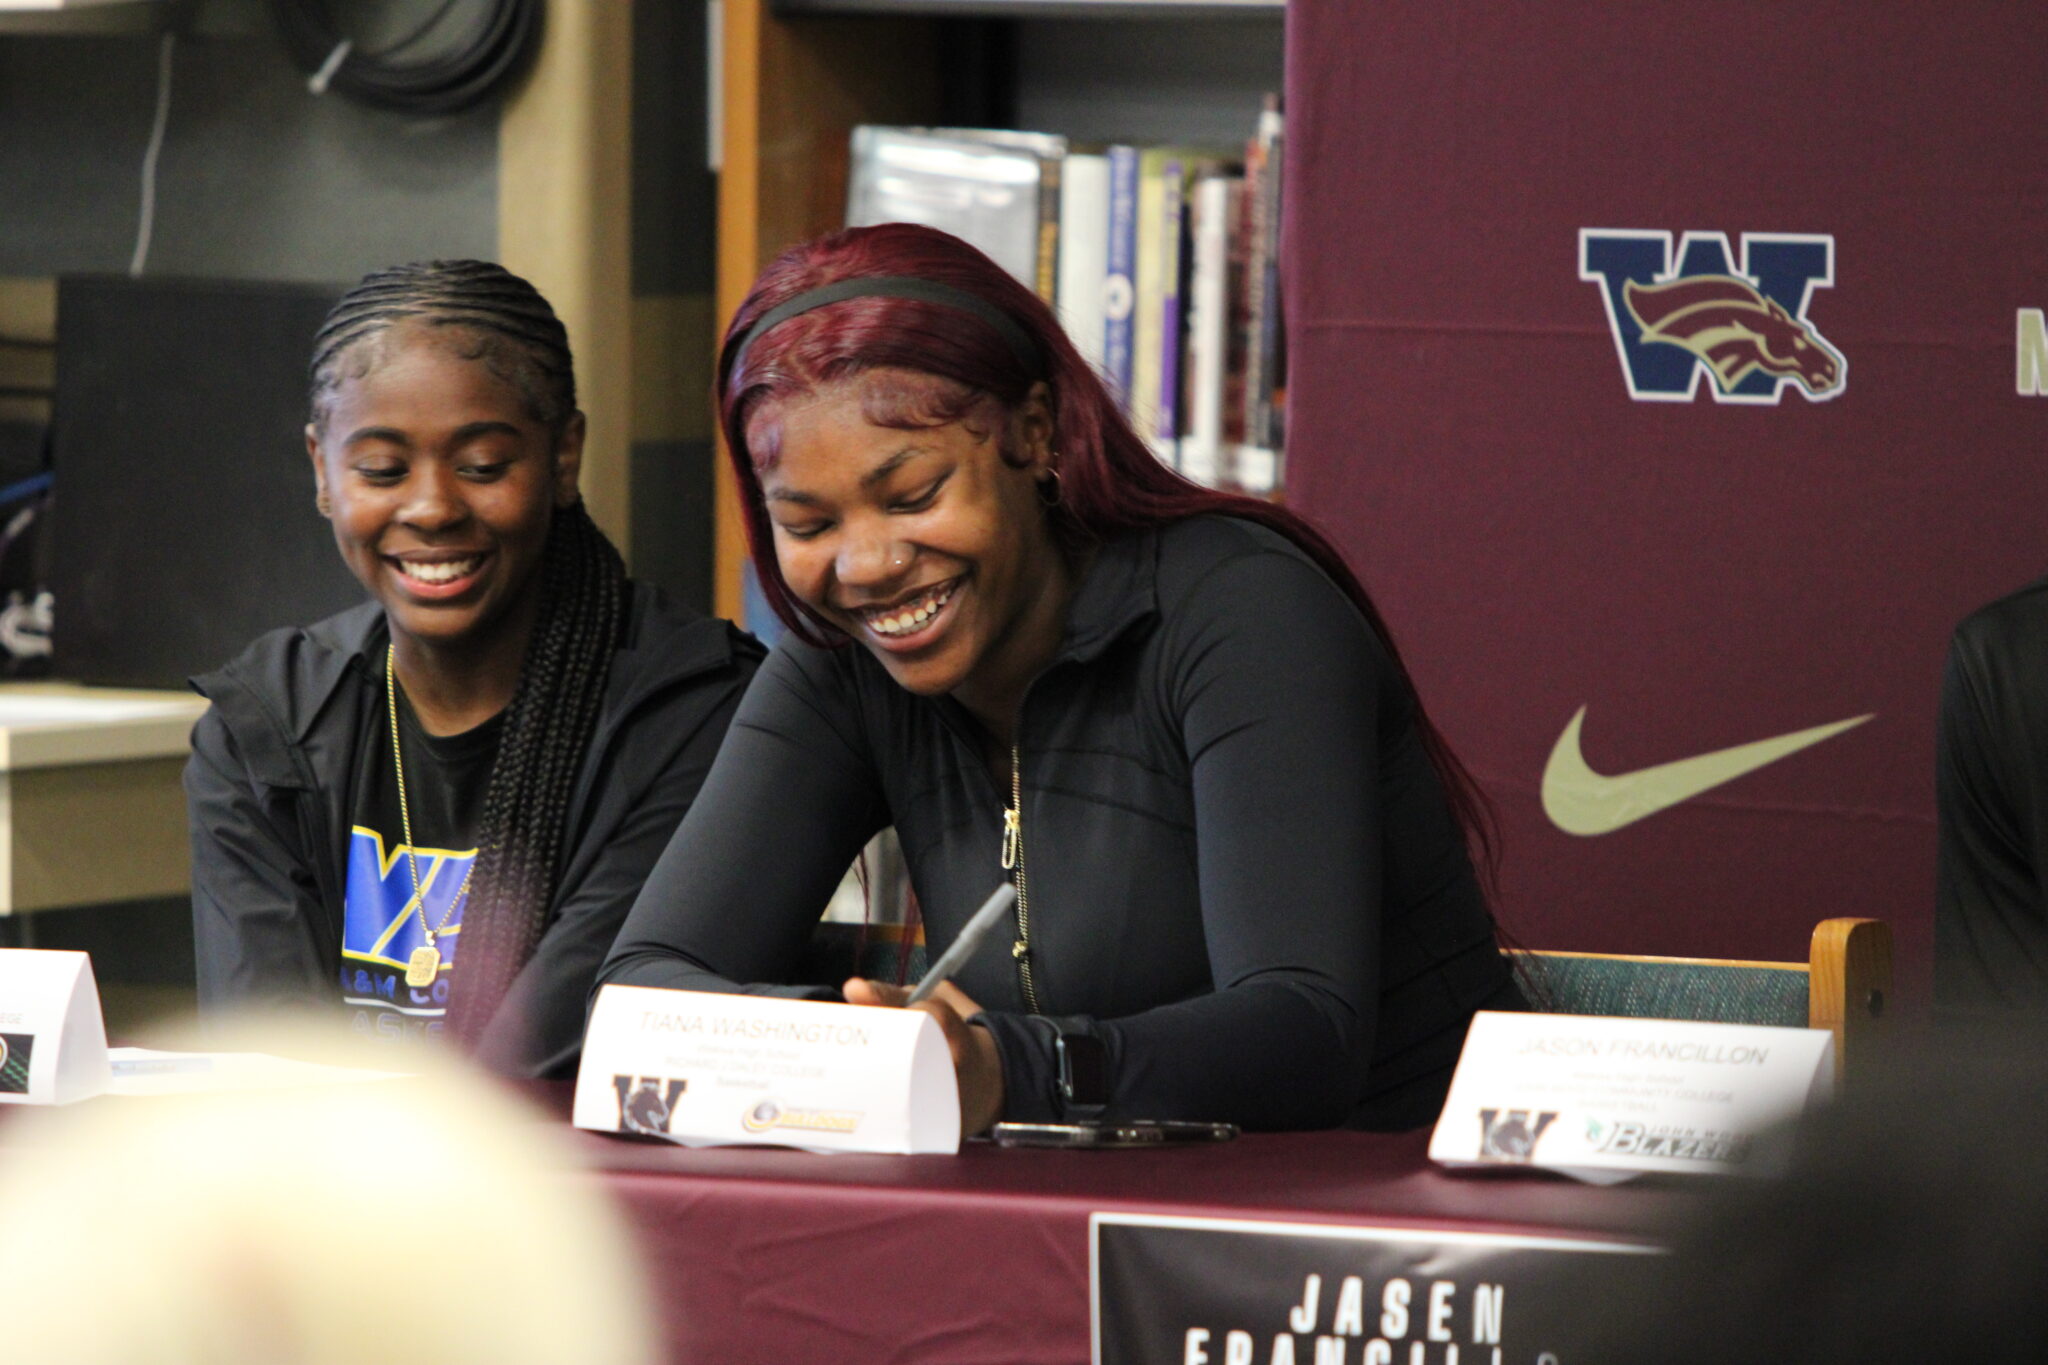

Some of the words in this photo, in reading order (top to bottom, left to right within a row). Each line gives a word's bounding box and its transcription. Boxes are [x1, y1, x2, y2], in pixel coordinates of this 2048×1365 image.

[640, 1011, 704, 1033] TIANA
[711, 1016, 870, 1047] WASHINGTON
[1518, 1038, 1599, 1057] JASON
[1608, 1040, 1770, 1065] FRANCILLON
[1290, 1274, 1504, 1345] JASEN
